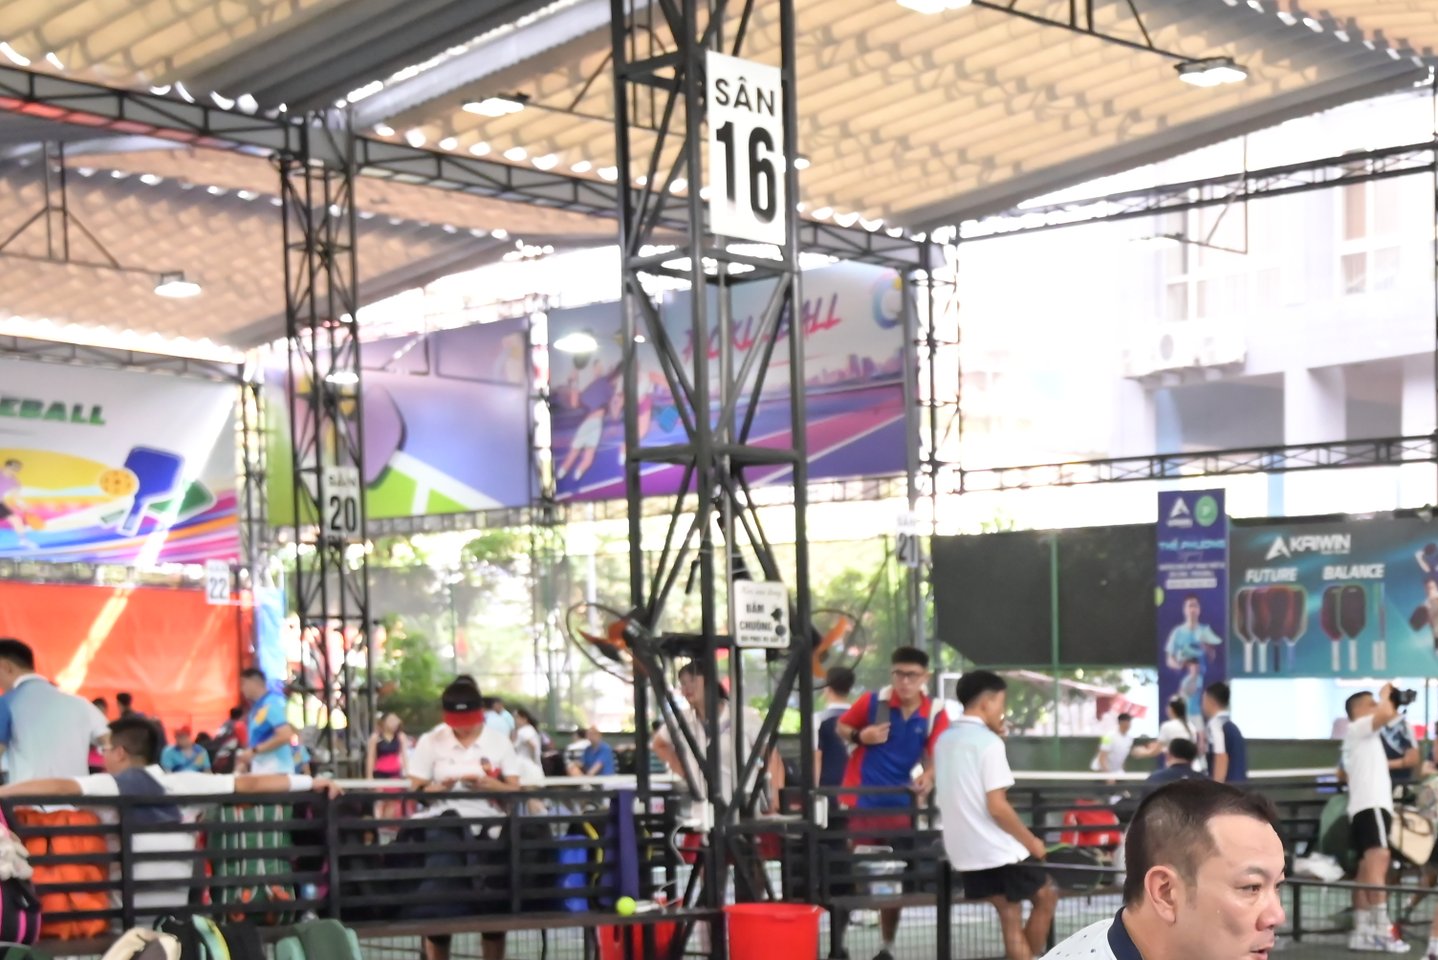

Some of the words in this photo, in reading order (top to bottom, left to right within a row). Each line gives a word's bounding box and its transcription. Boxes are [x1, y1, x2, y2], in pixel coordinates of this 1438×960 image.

[715, 76, 775, 117] SÂN
[716, 121, 776, 224] 16
[330, 495, 356, 533] 20
[898, 532, 915, 562] 21
[1245, 567, 1298, 583] FUTURE
[1322, 563, 1385, 581] BALANCE
[209, 577, 228, 600] 22
